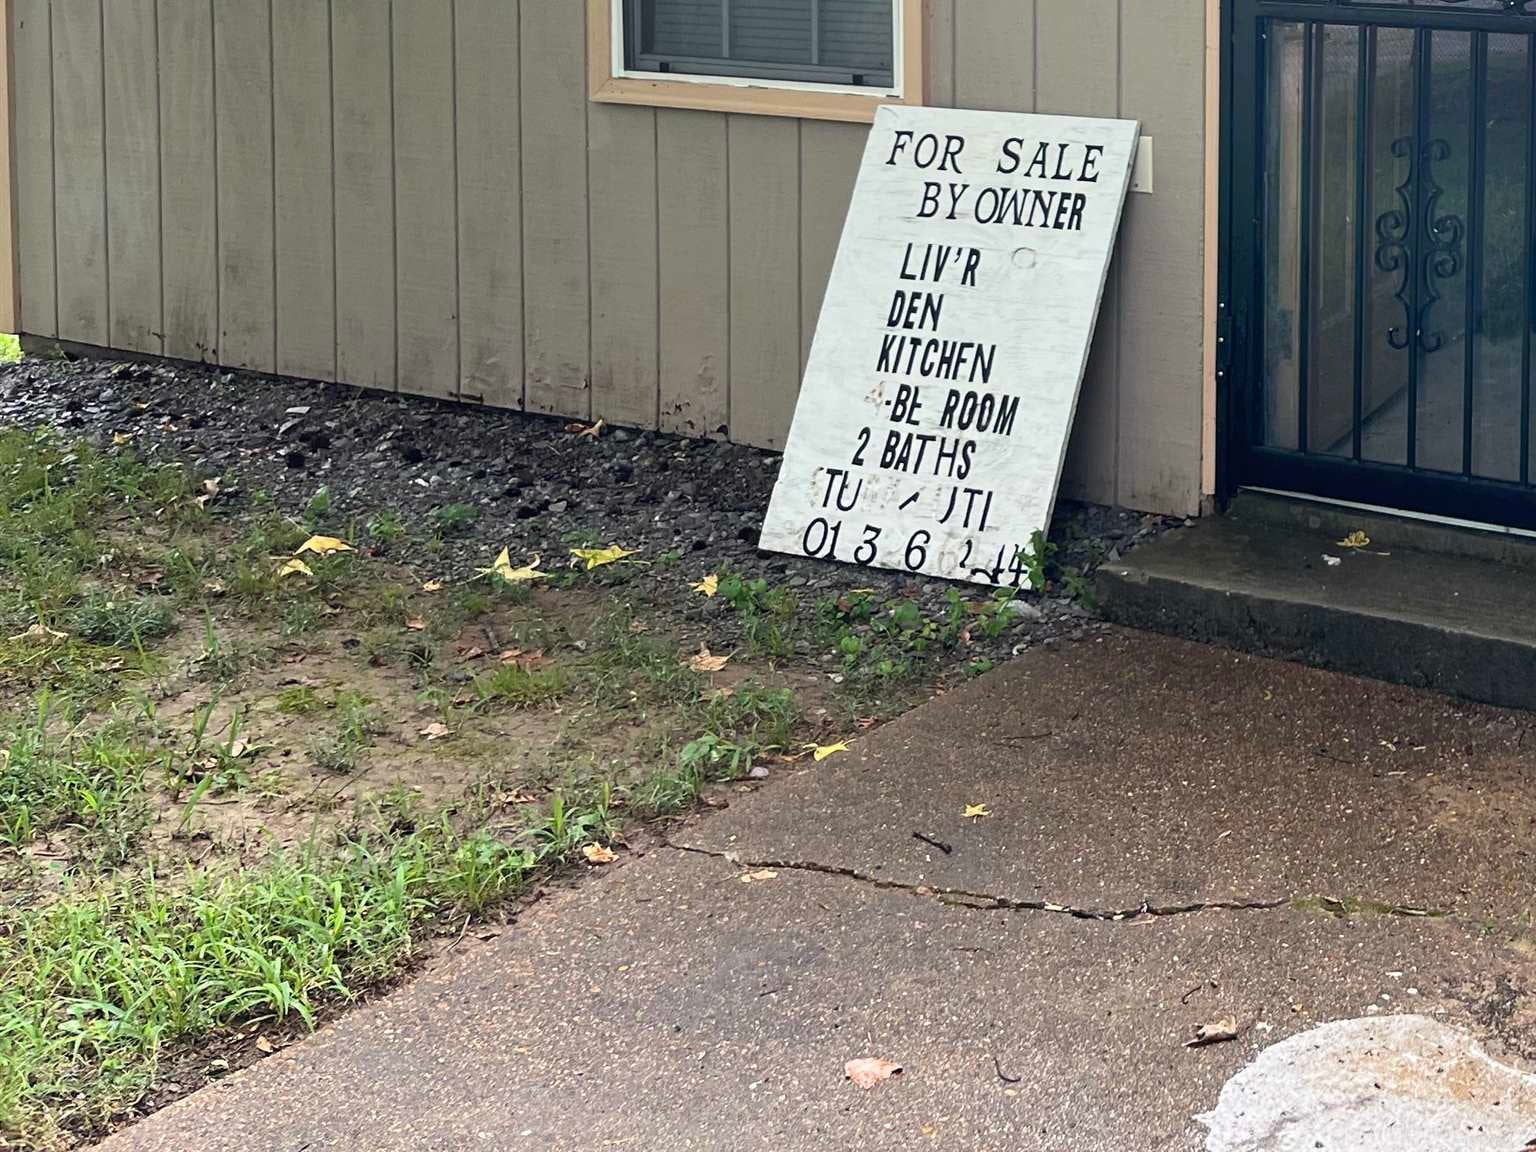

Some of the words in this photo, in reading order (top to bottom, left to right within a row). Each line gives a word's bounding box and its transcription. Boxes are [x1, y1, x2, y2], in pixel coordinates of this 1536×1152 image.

[885, 130, 965, 174] FOR
[996, 137, 1104, 182] SALE
[916, 181, 970, 220] BY
[975, 186, 1087, 230] OWNER
[899, 242, 982, 287] LIV'R
[886, 290, 945, 332] DEN
[940, 389, 1020, 436] ROOM
[851, 427, 873, 466] 2
[879, 430, 977, 480] BATHS
